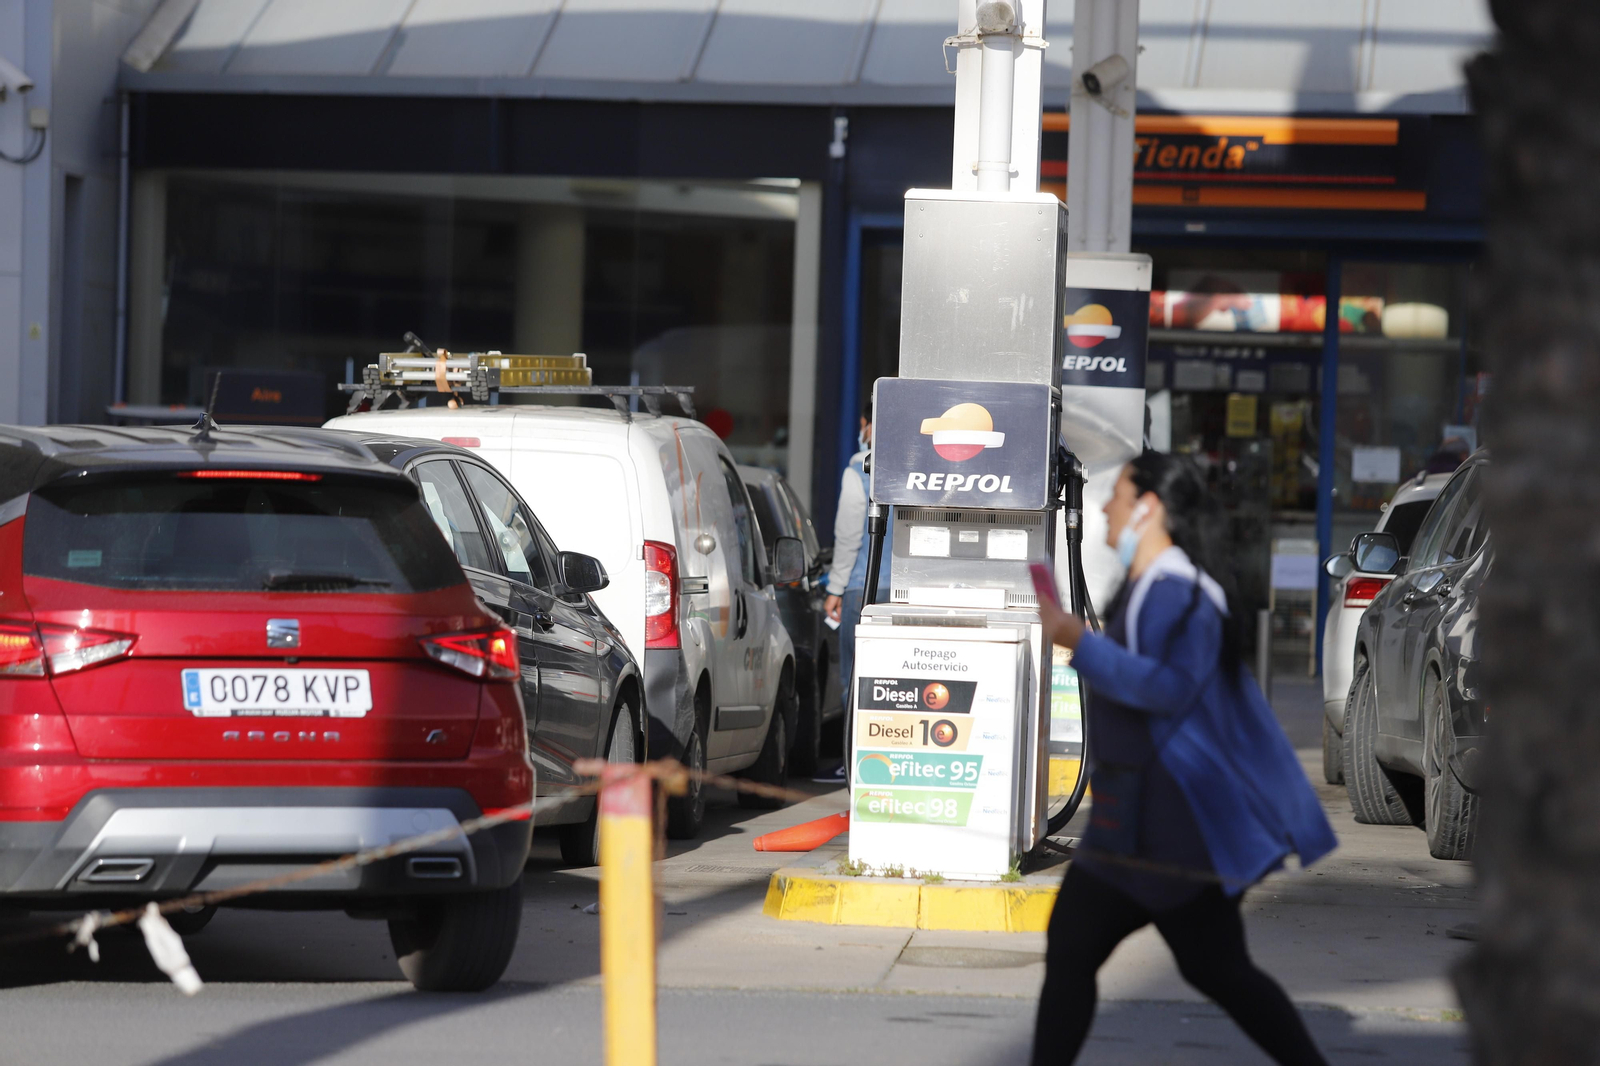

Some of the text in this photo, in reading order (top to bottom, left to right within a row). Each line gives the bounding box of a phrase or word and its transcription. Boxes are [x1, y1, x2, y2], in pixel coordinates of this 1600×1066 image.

[1134, 136, 1246, 169] Tienda
[1061, 354, 1128, 373] EPSOL
[906, 472, 1013, 493] REPSOL
[913, 647, 957, 659] Prepago
[901, 660, 968, 671] Autoservicio
[211, 675, 360, 703] 0078 KVP
[872, 686, 919, 703] Diesel
[868, 719, 958, 747] Diesel 10
[889, 761, 978, 781] efitec 95
[868, 798, 958, 818] efitec 98
